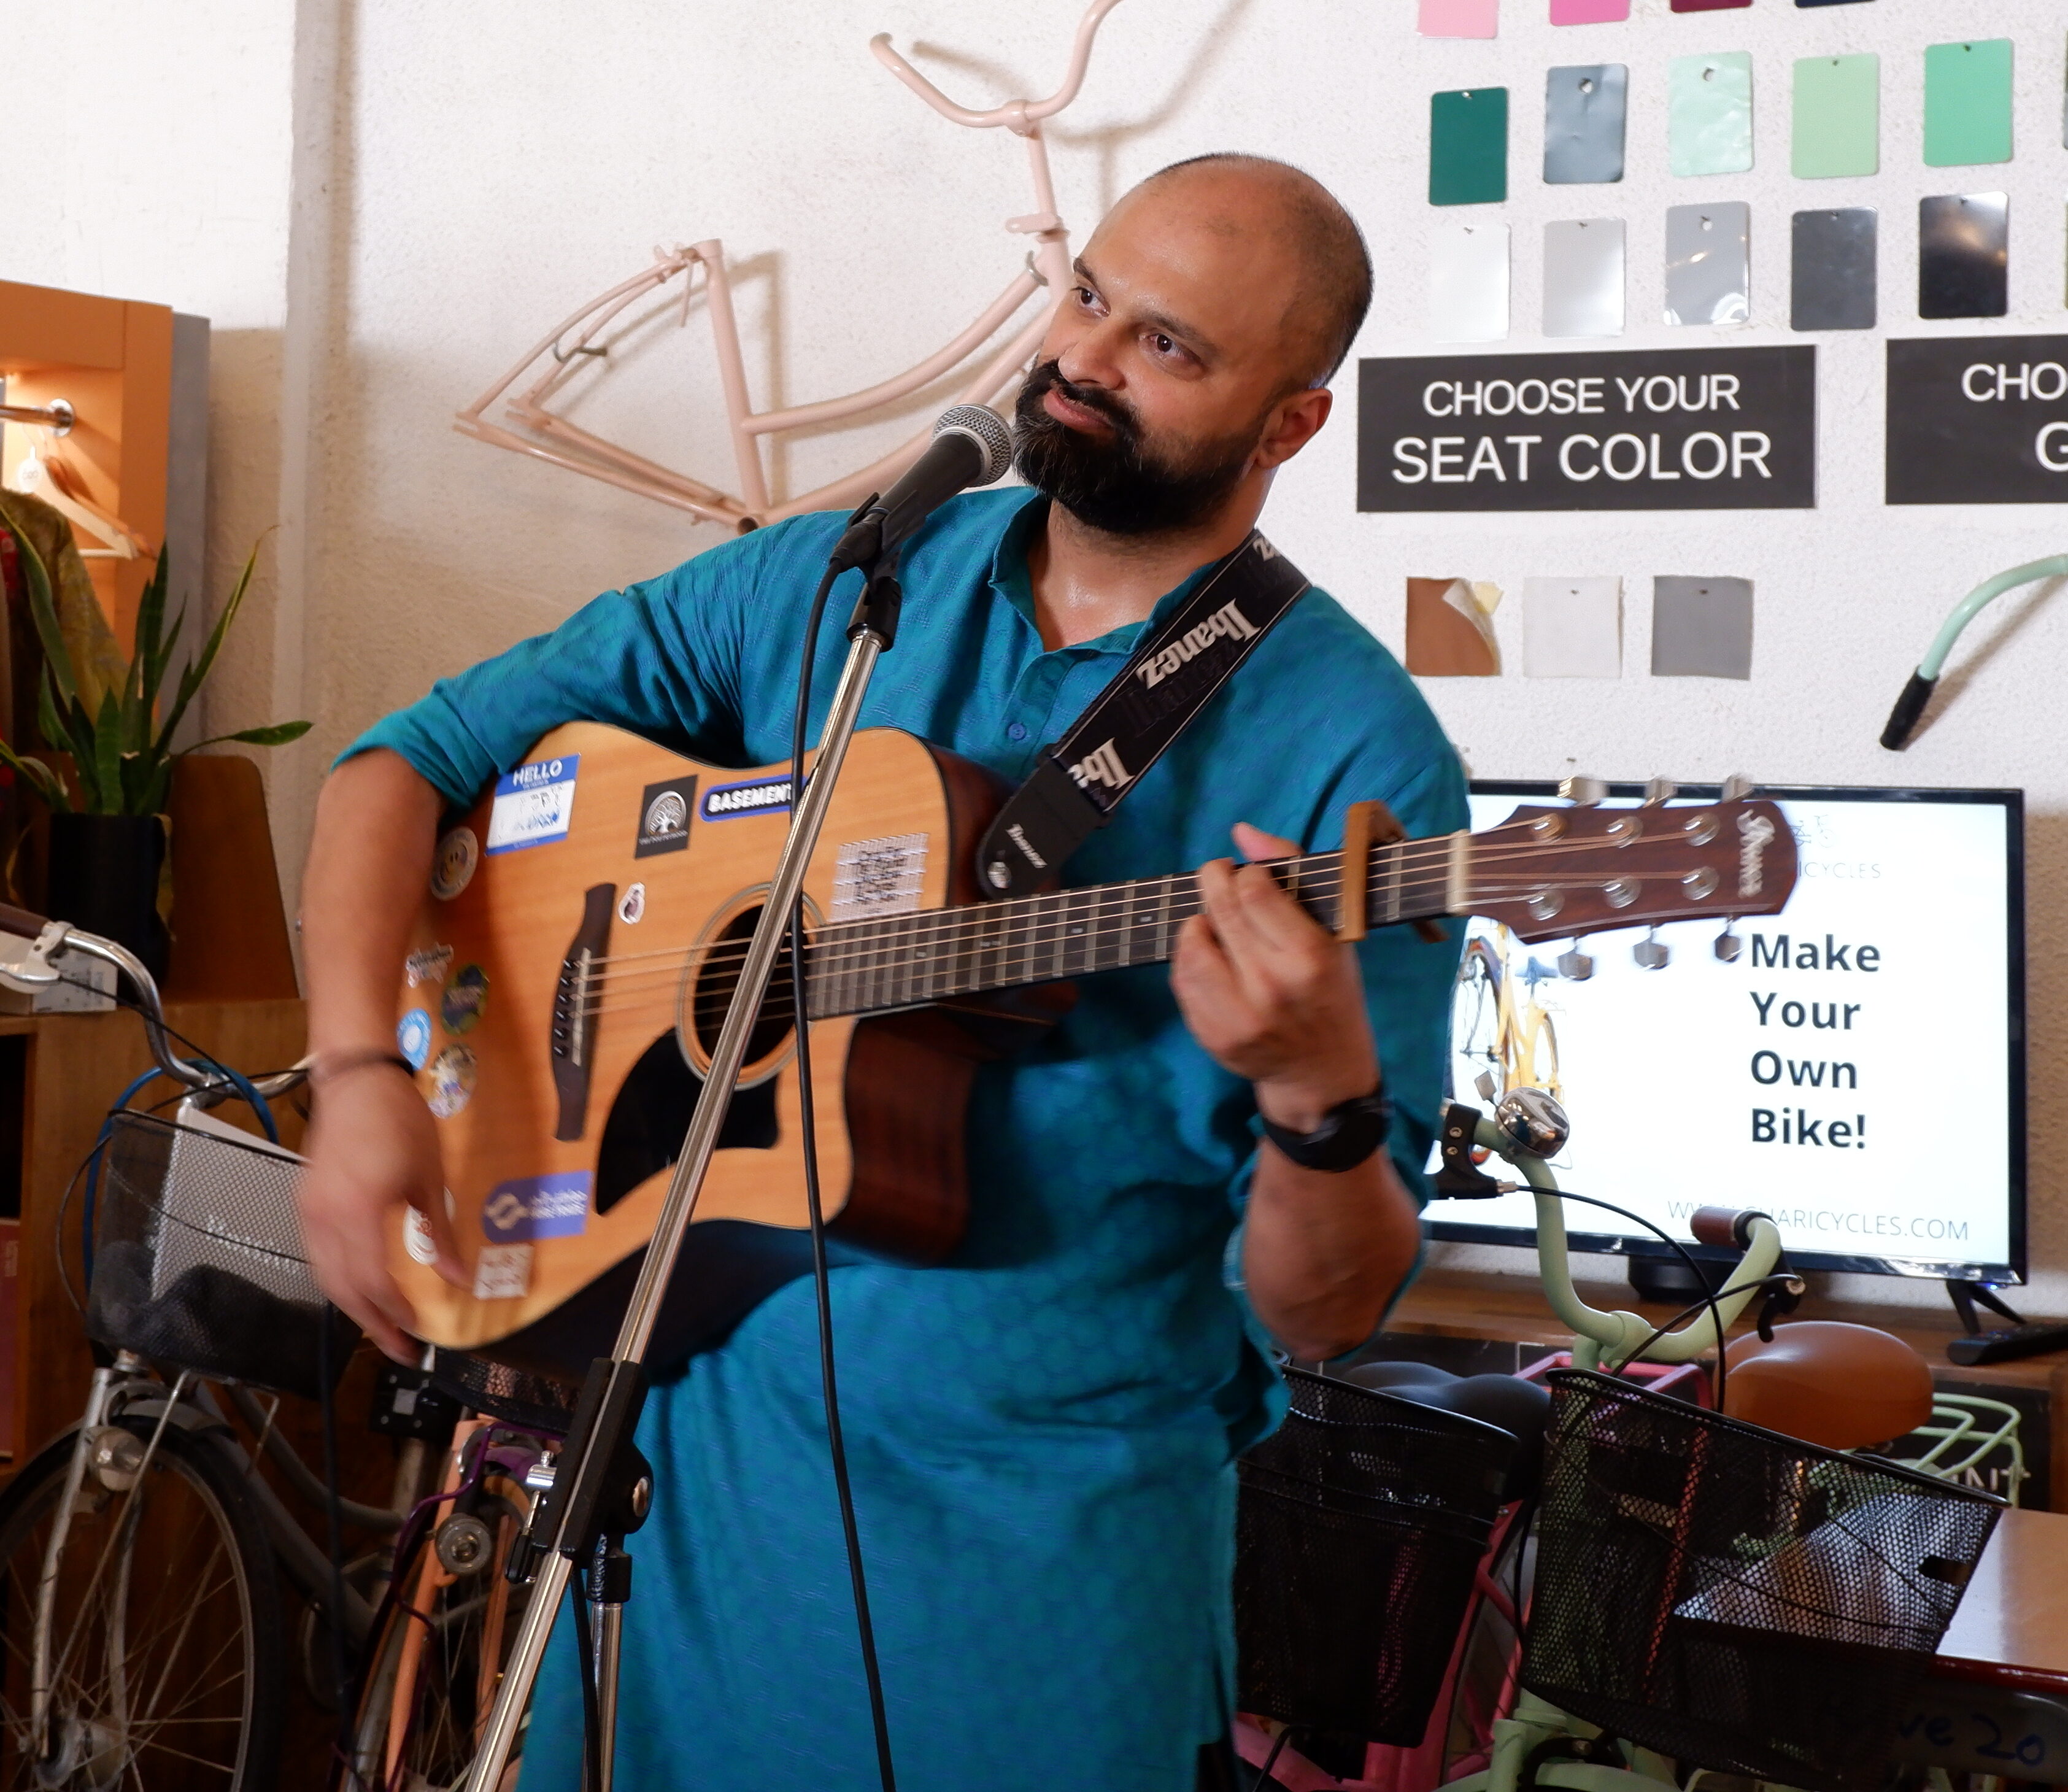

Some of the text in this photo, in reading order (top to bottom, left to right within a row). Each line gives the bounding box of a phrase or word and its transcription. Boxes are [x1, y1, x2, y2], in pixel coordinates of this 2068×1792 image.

[1423, 374, 1740, 418] CHOOSE YOUR
[1961, 361, 2068, 403] CHO
[1392, 431, 1772, 484] SEAT COLOR
[1136, 598, 1261, 689] Ibanez
[512, 759, 563, 786] HELLO
[1750, 933, 1881, 972] Make
[1748, 992, 1861, 1030] Your
[1750, 1050, 1858, 1089] Own
[1751, 1108, 1867, 1149] Bike!
[1971, 1712, 2046, 1767] 20
